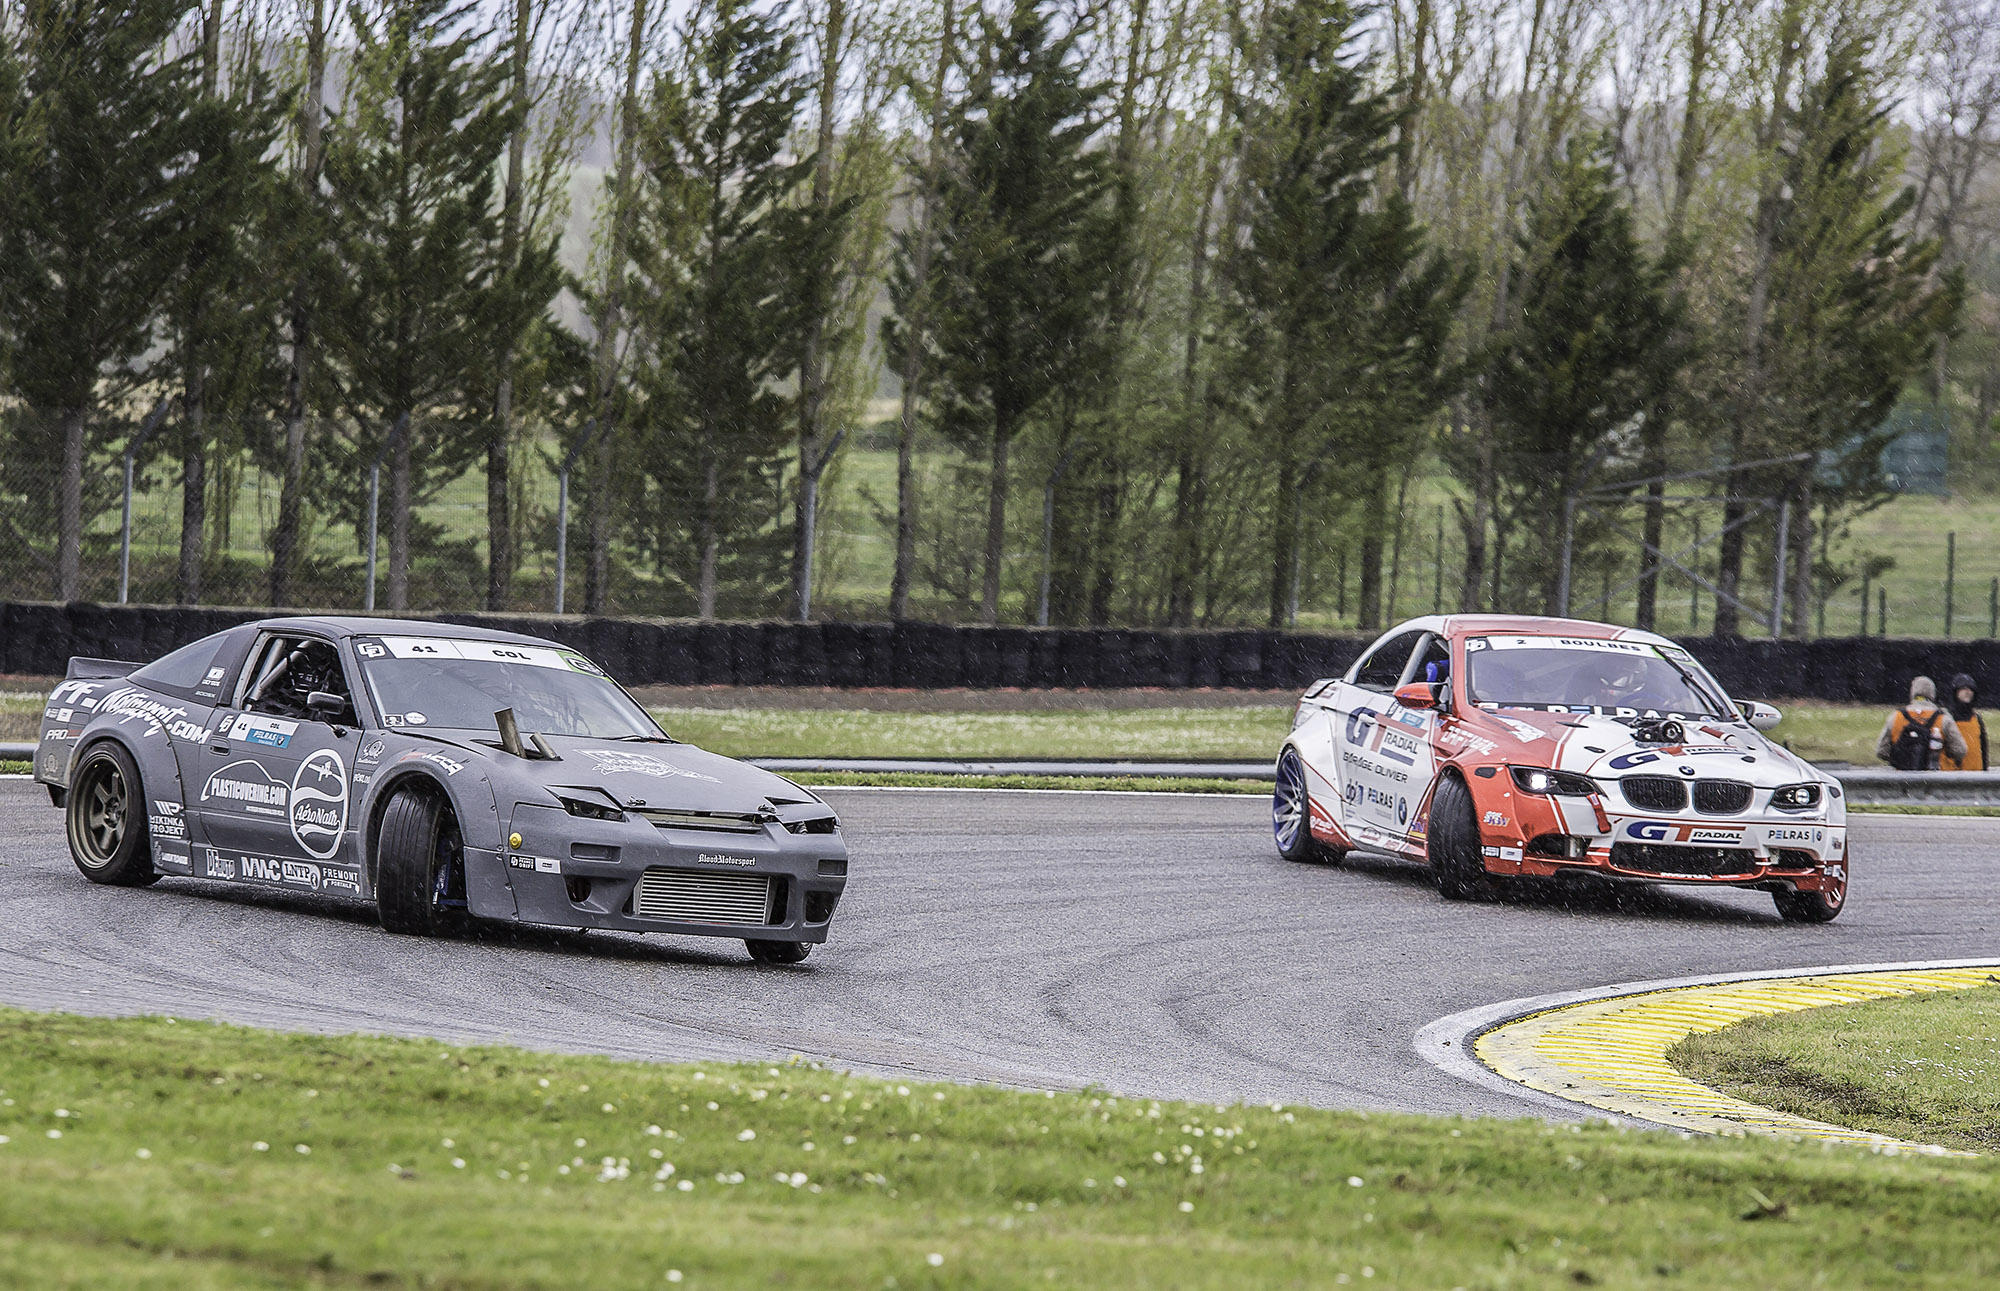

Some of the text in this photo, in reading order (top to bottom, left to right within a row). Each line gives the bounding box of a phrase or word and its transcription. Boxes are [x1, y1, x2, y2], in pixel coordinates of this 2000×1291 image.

[411, 645, 438, 653] 41
[492, 649, 531, 660] COL
[1560, 639, 1641, 651] BOULBES
[237, 722, 247, 731] 41
[1346, 707, 1410, 753] GT
[1383, 732, 1418, 755] RADIAL
[252, 730, 278, 741] PELRAS
[210, 777, 287, 806] PLASTICOVERING.COM
[1368, 787, 1394, 809] PELRAS
[1626, 821, 1742, 842] GT RADIAL
[1768, 829, 1810, 840] PELRAS
[322, 867, 358, 882] FREMONT
